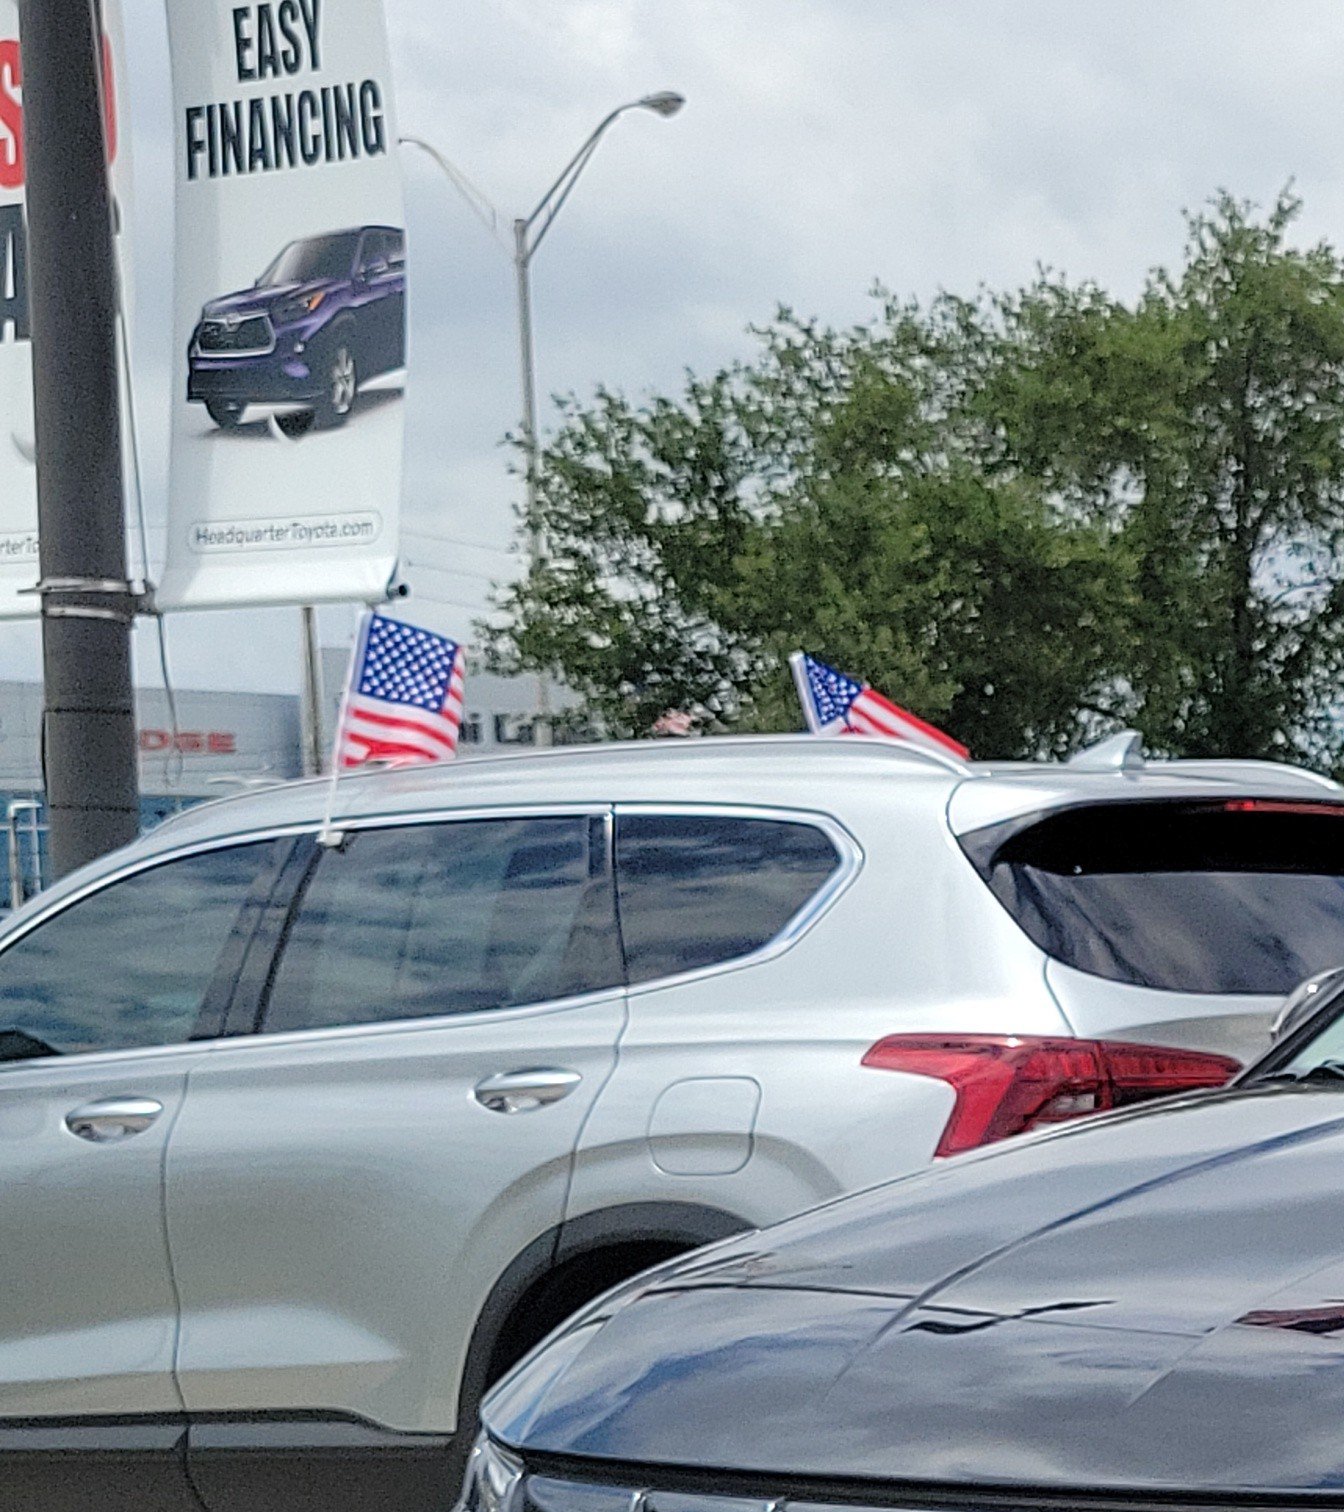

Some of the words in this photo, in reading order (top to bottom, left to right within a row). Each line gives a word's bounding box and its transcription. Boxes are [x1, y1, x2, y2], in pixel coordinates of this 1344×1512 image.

[233, 0, 321, 82] EASY
[186, 80, 387, 180] FINANCING
[196, 522, 373, 546] HeadquarterToyota.com
